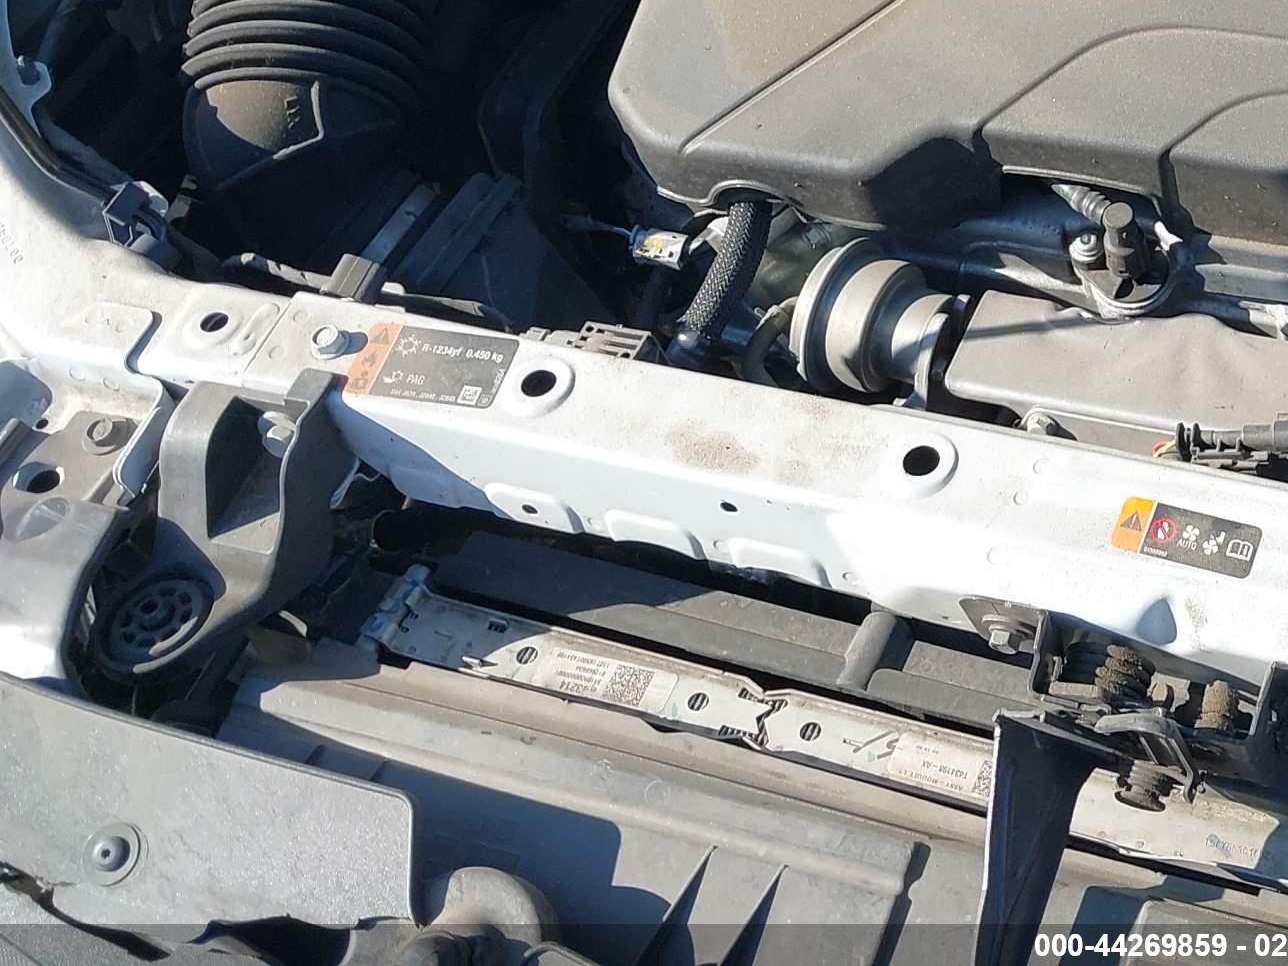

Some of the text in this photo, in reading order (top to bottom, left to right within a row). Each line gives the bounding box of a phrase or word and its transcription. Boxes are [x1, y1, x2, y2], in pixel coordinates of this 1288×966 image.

[421, 343, 504, 364] R-1234yf 0.450 kg
[406, 374, 425, 385] PAG
[1176, 539, 1197, 551] AUTO
